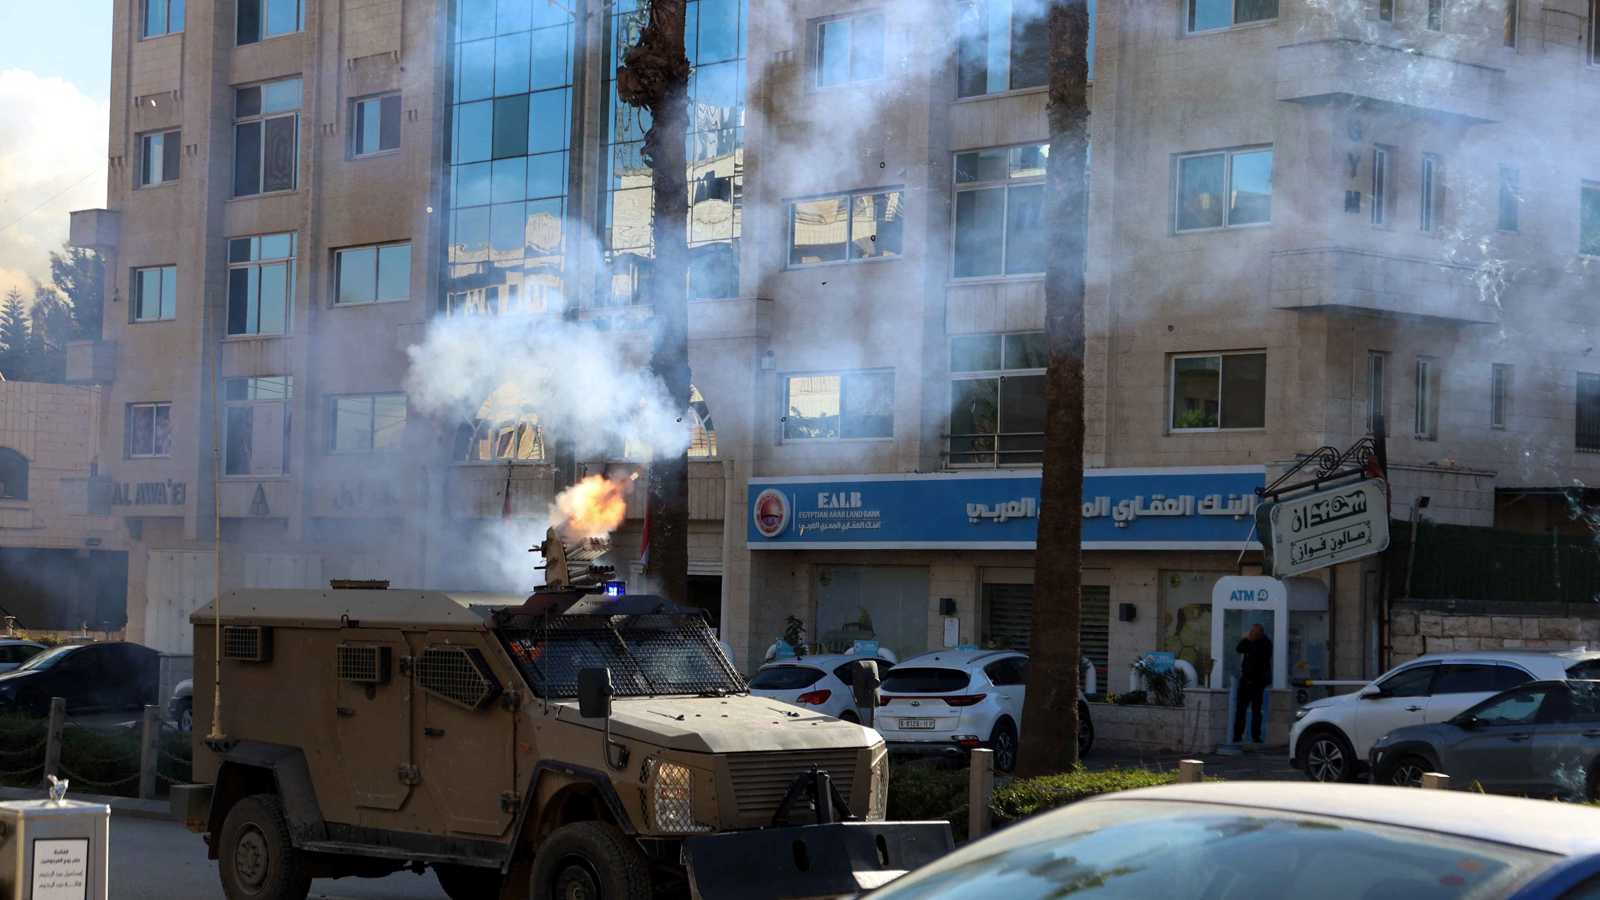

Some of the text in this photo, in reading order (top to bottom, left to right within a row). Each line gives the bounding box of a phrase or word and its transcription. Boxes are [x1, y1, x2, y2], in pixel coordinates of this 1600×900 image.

[817, 491, 863, 508] EALB
[966, 497, 1036, 523] العربي
[1198, 493, 1258, 520] البنك
[799, 511, 828, 519] EGYPTIAN
[1112, 494, 1195, 528] العقاري
[1230, 589, 1255, 601] ATM
